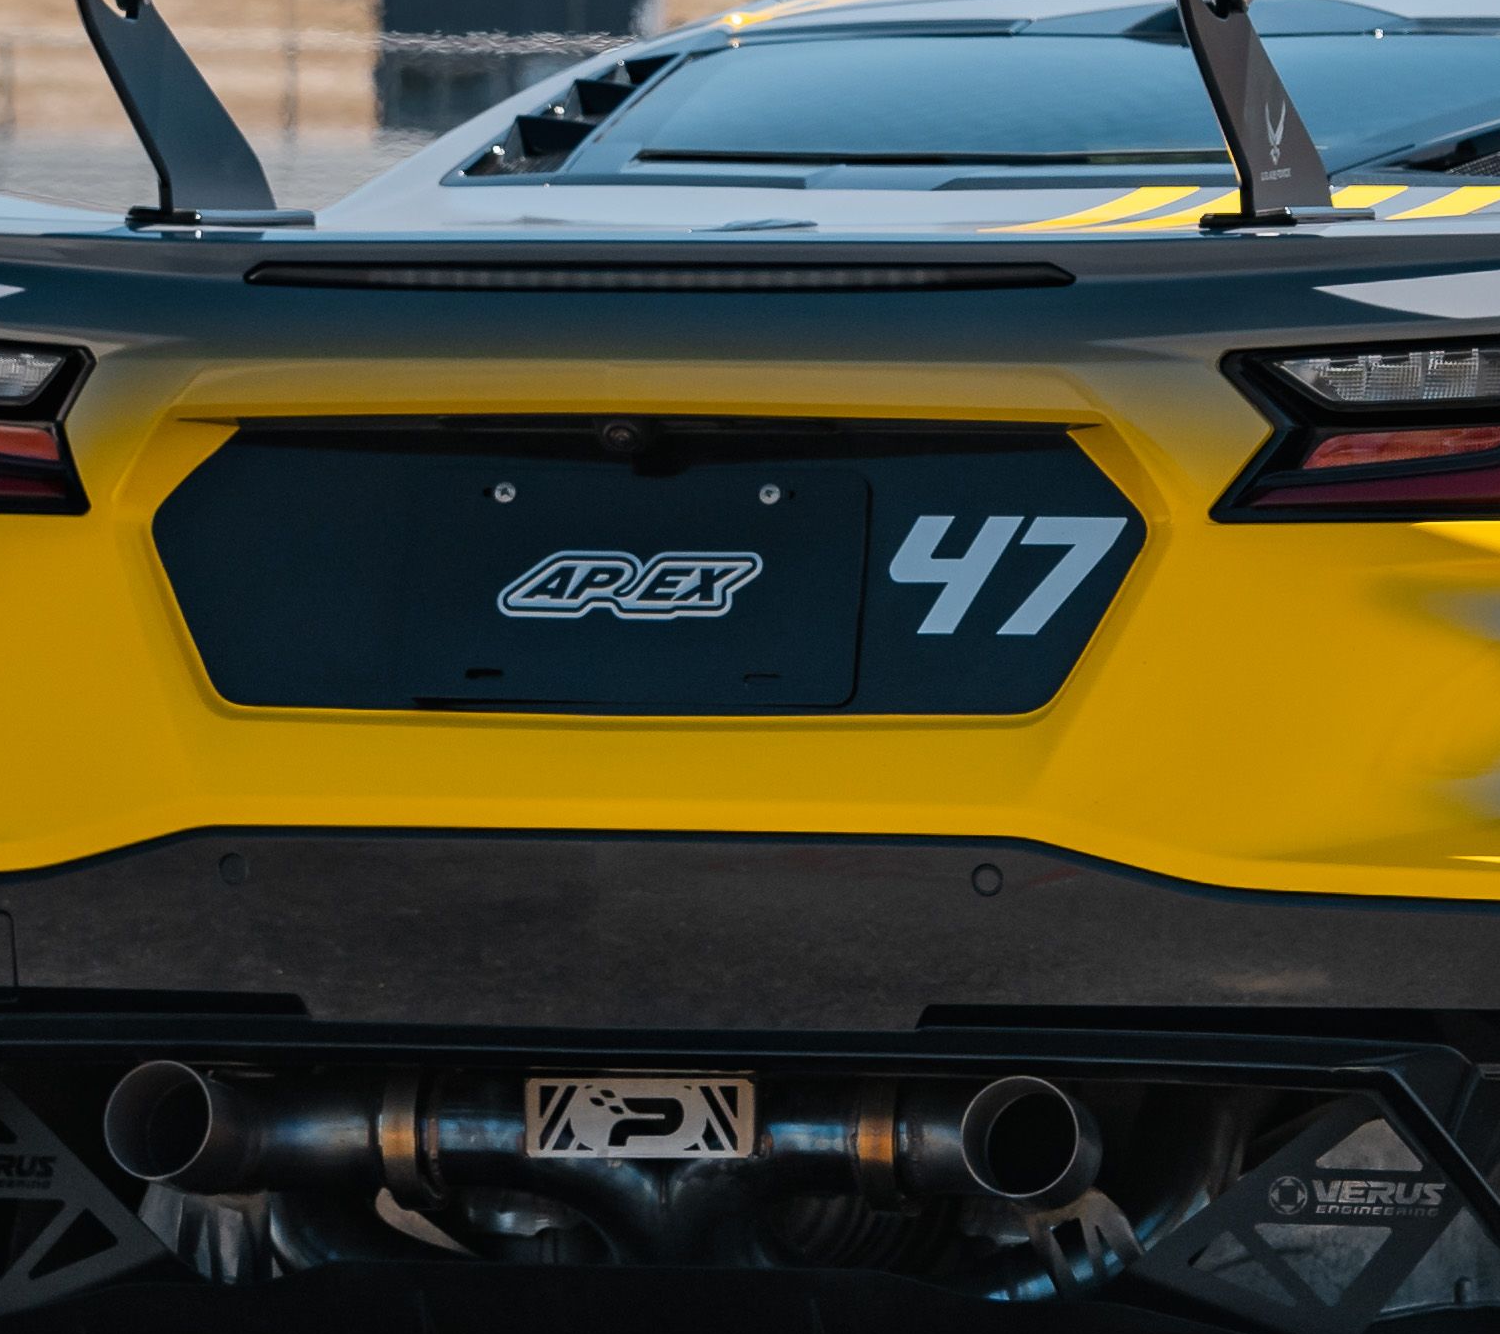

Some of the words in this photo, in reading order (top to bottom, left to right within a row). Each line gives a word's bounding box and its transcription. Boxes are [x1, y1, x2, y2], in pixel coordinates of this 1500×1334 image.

[506, 556, 752, 611] APEX
[889, 514, 1128, 635] 47
[1311, 1179, 1446, 1205] VERUS
